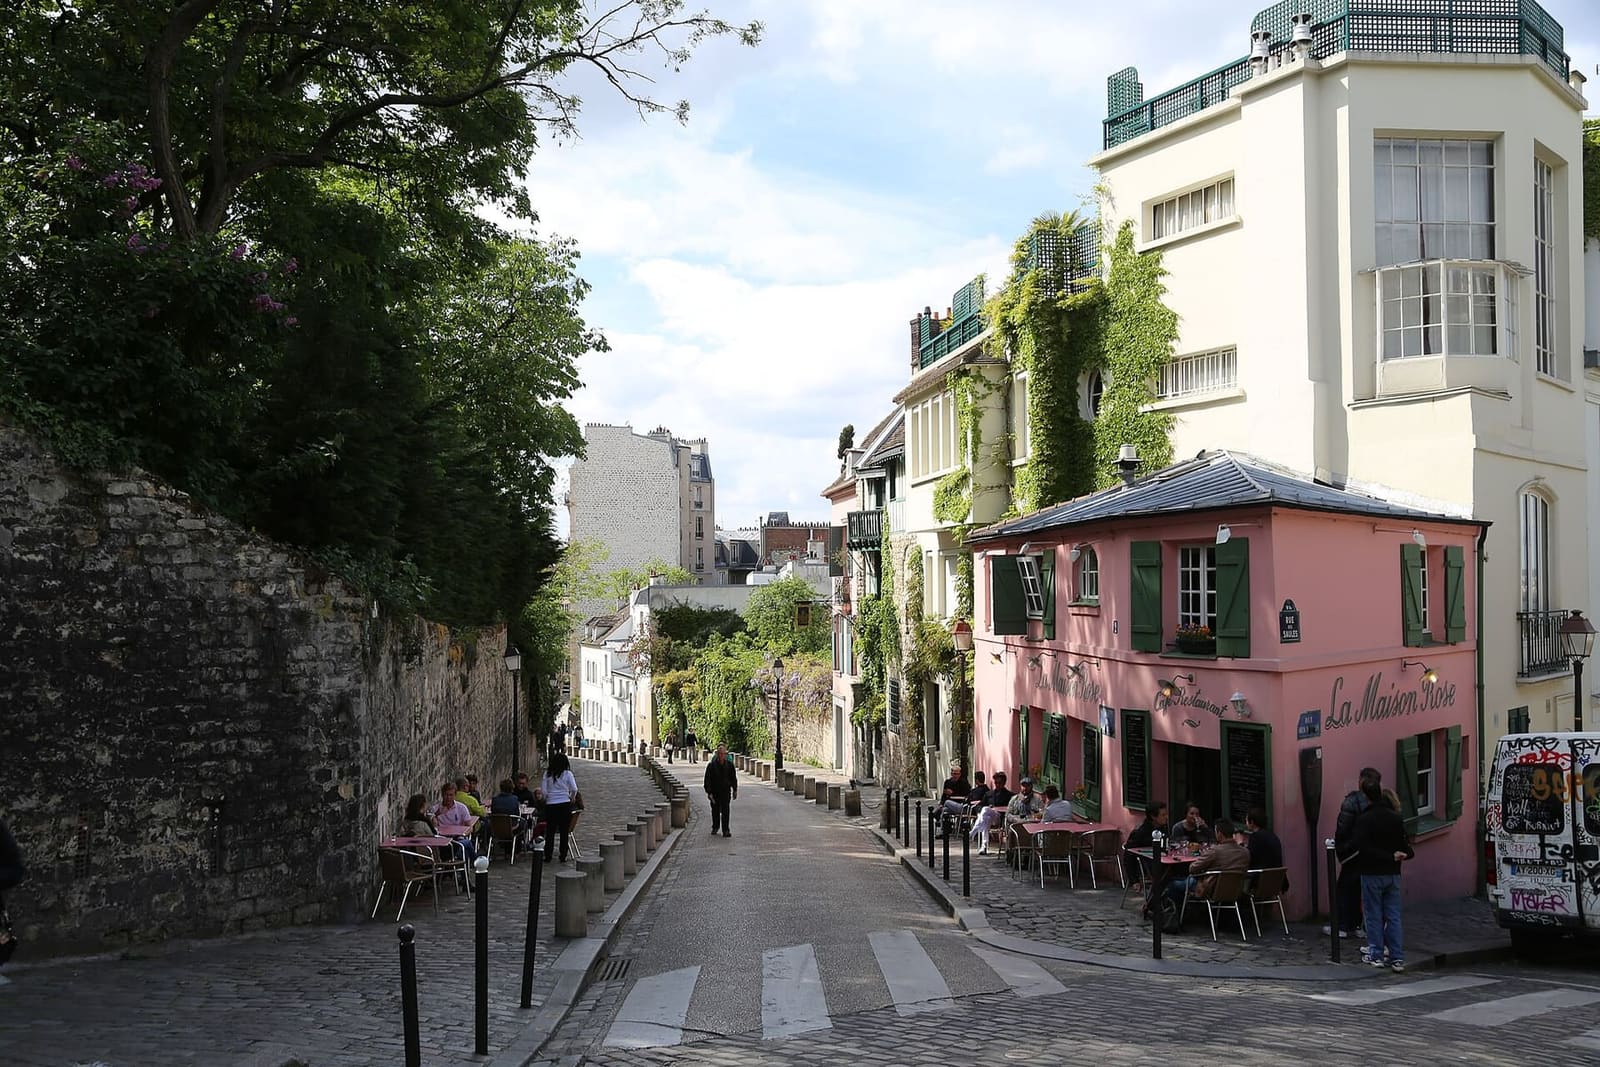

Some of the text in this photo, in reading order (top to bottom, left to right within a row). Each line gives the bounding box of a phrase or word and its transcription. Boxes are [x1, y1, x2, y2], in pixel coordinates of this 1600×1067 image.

[1174, 686, 1228, 718] Restaurant
[1325, 672, 1456, 730] La Maison Rose
